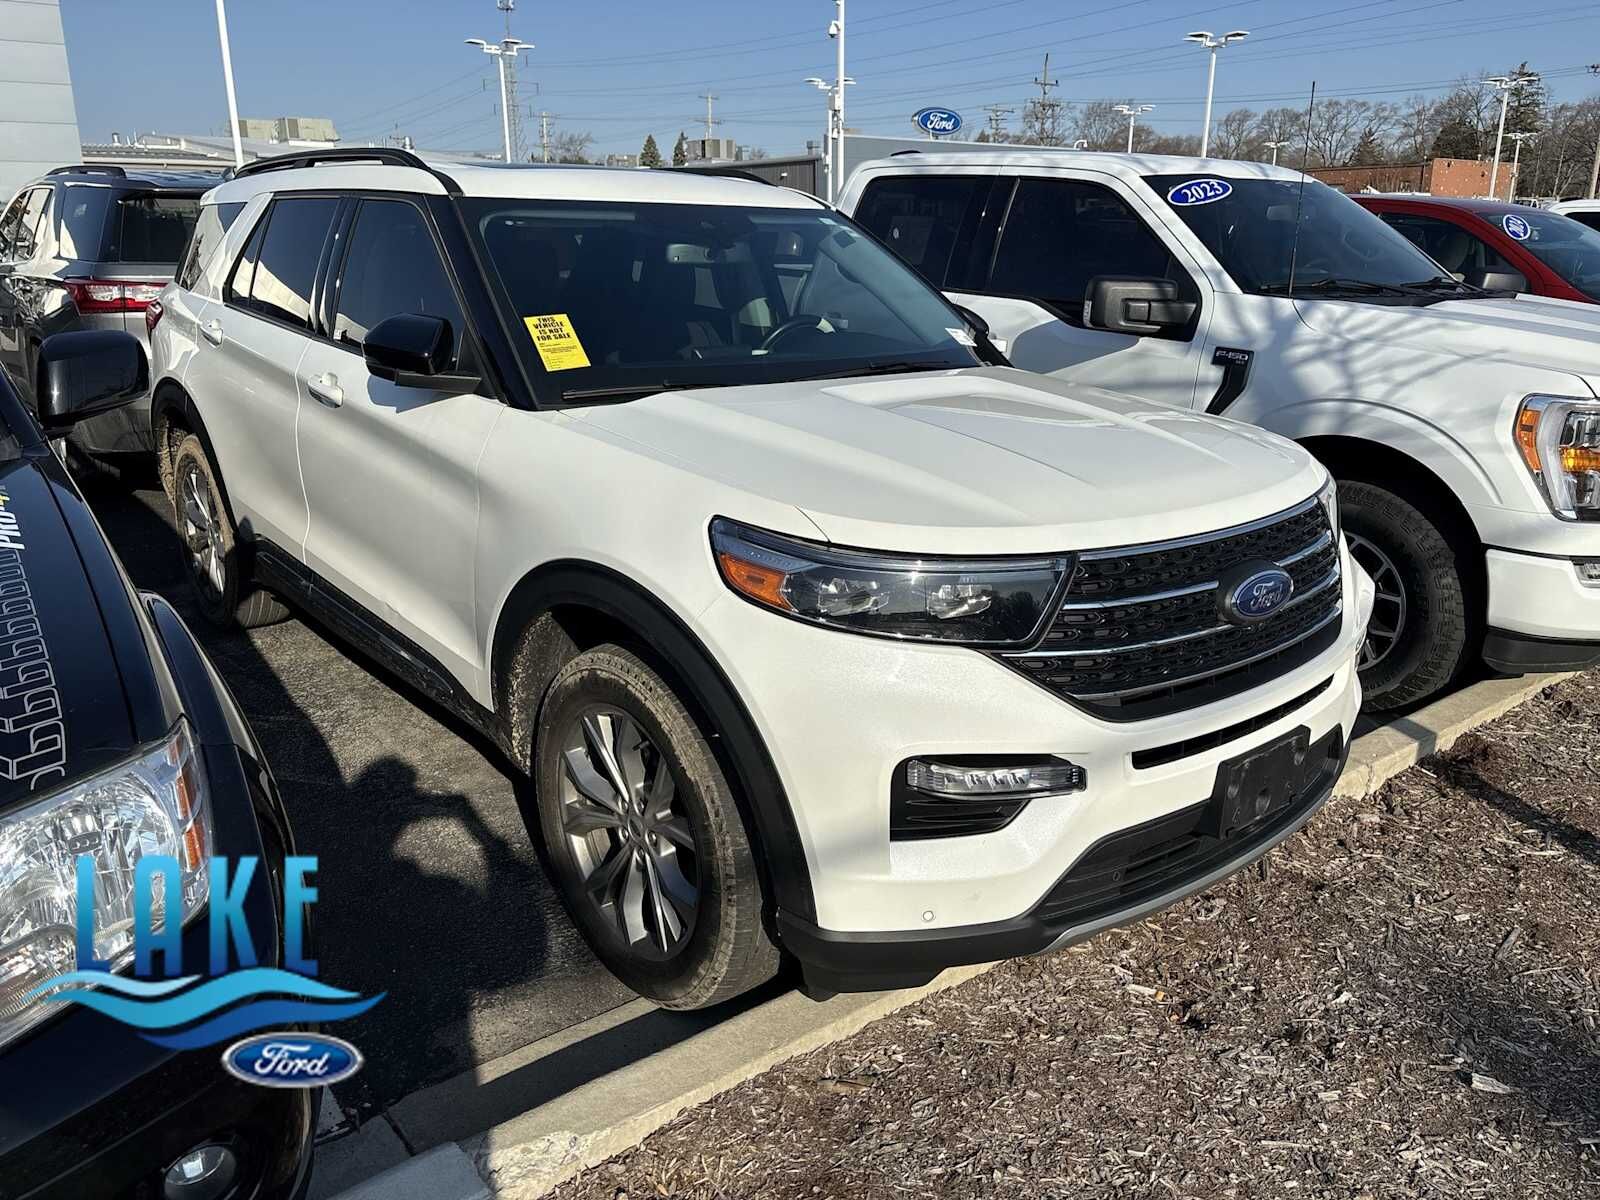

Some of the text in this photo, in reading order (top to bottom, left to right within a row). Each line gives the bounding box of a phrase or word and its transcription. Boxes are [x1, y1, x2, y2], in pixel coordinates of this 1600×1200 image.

[927, 112, 955, 130] Ford
[1181, 181, 1223, 203] 2023
[533, 321, 564, 330] VEHICLE
[537, 316, 556, 324] THIS
[554, 332, 571, 340] SALE
[1215, 350, 1249, 361] F-150
[1250, 581, 1283, 609] Ford
